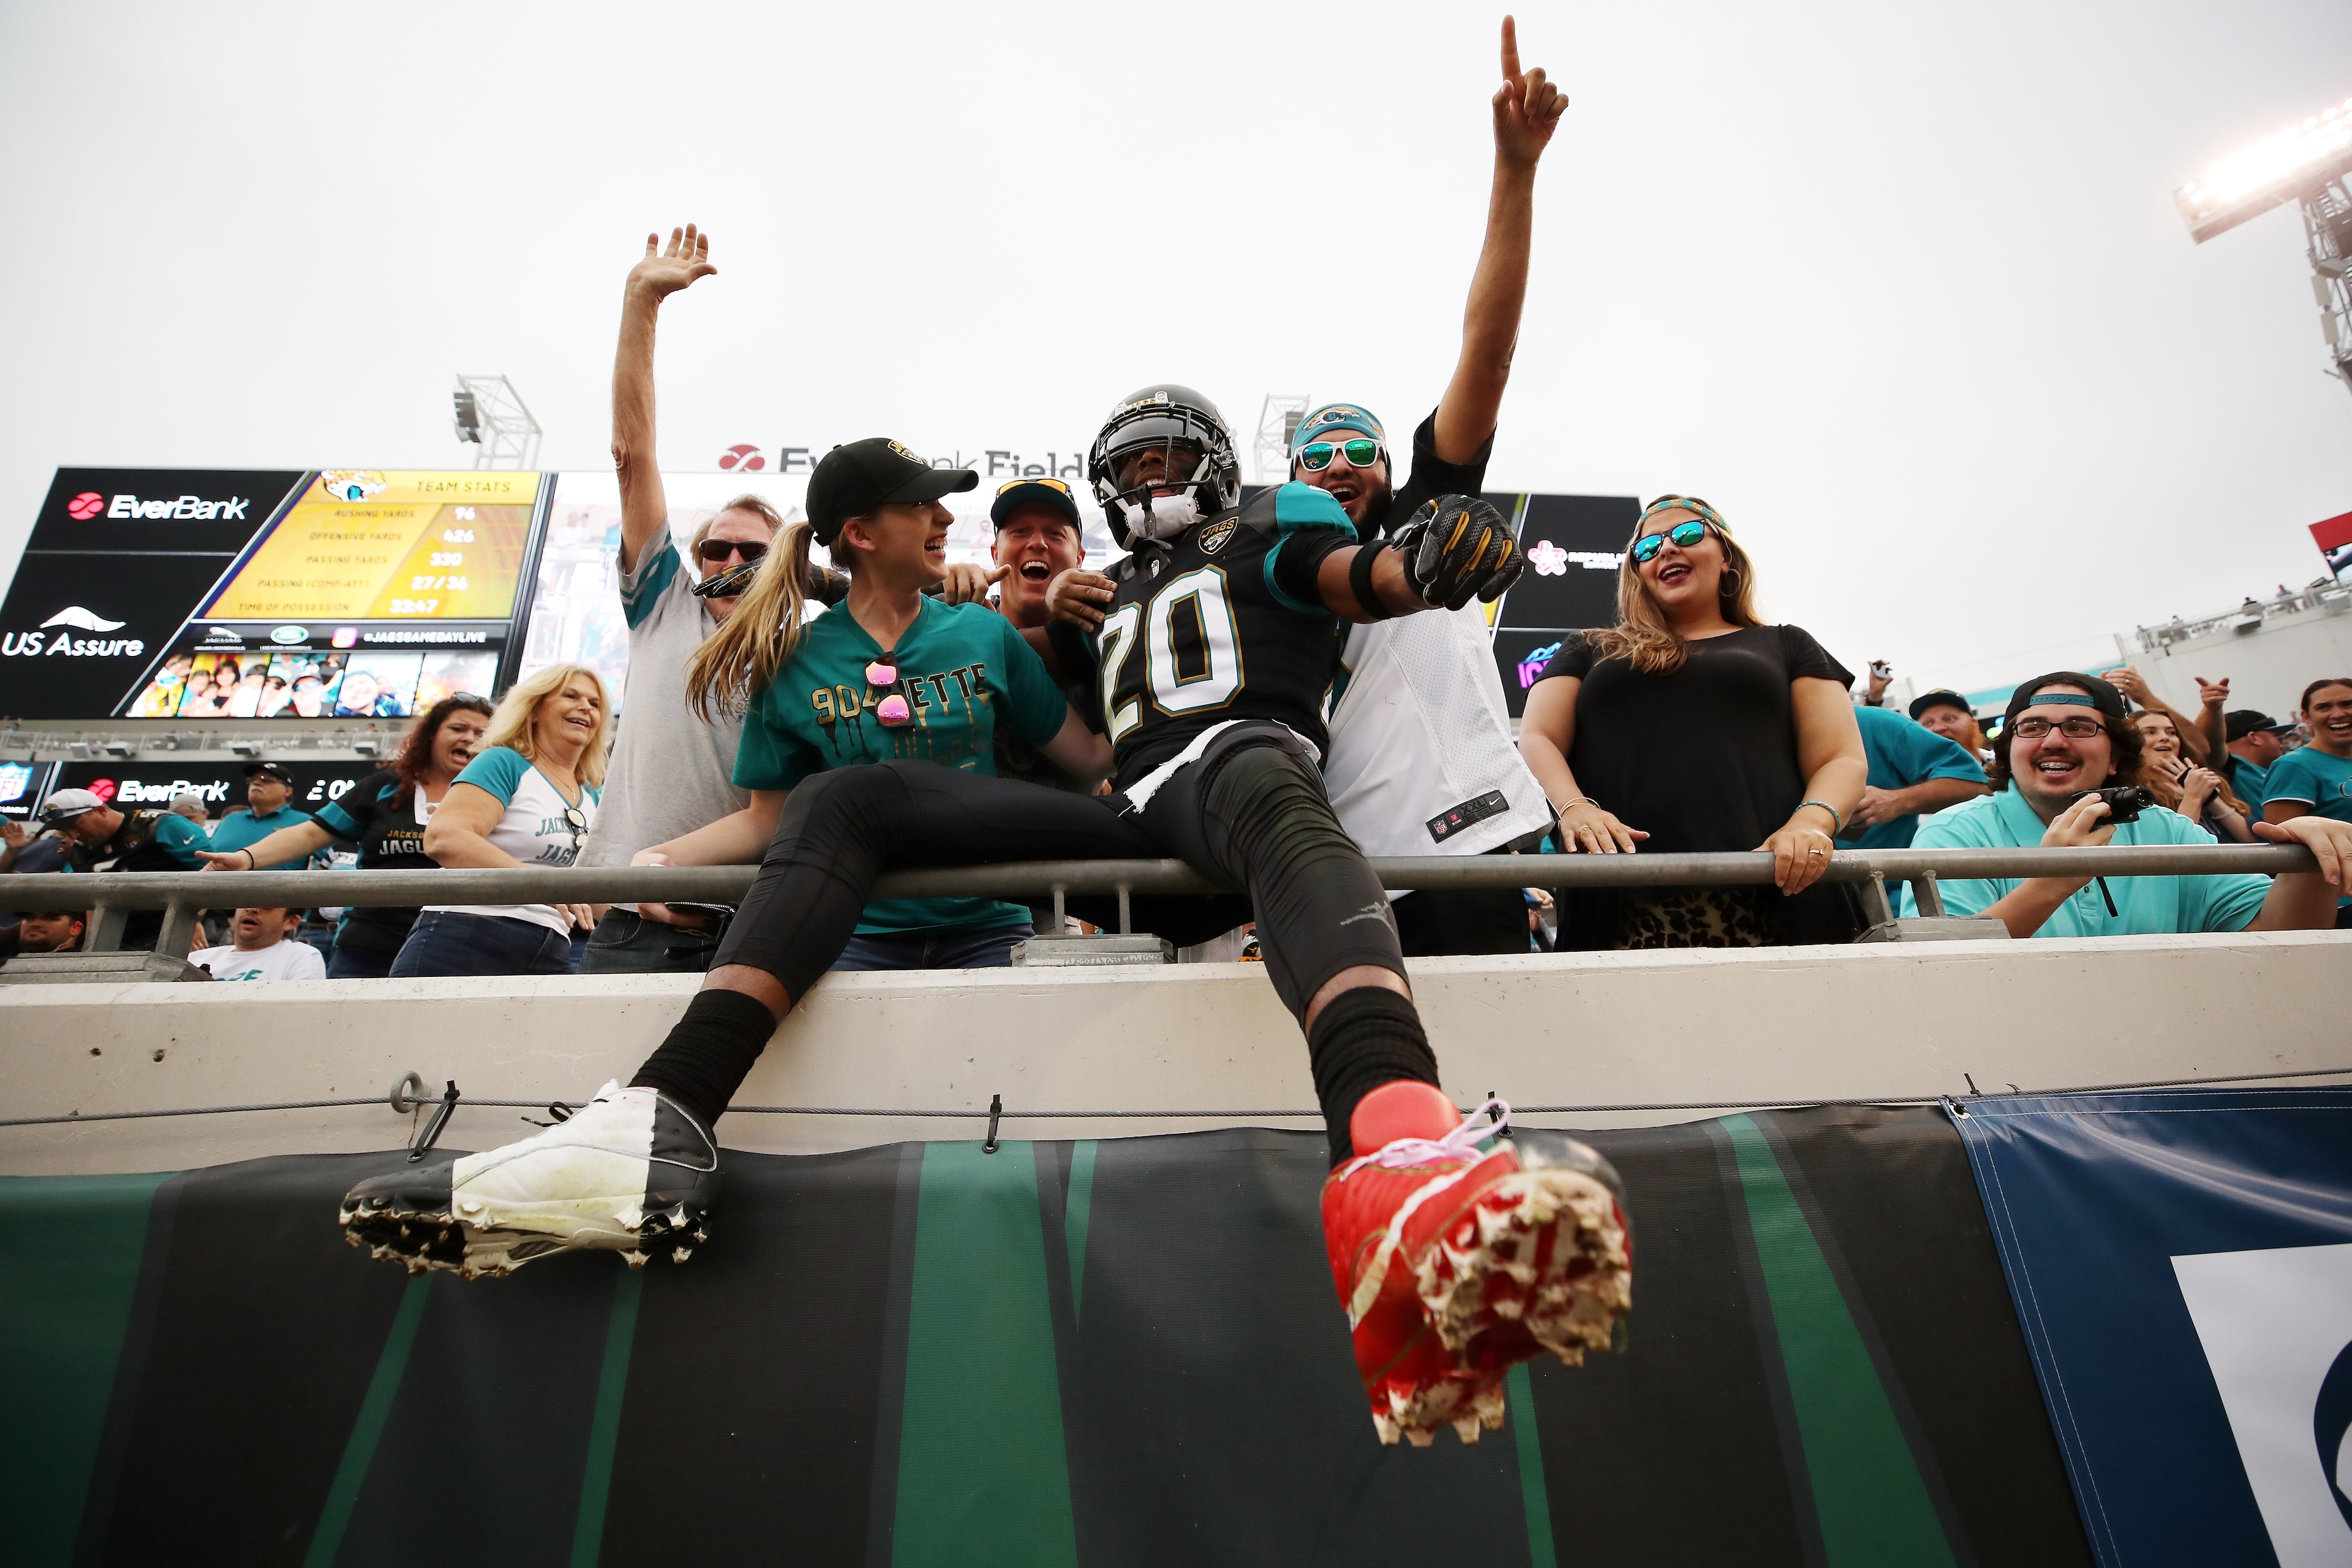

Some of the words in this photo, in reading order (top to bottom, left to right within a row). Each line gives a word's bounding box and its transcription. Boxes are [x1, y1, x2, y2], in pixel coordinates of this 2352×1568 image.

[986, 451, 1082, 477] Field
[417, 481, 458, 491] TEAM
[463, 481, 511, 492] STATS
[107, 494, 247, 520] EverBank
[455, 506, 476, 520] 96
[443, 529, 475, 543] 426
[1202, 519, 1235, 538] JAGS
[429, 552, 463, 566] 330
[257, 579, 303, 588] PASSING
[411, 576, 469, 590] 27/36
[239, 603, 262, 611] TIME
[266, 603, 279, 611] OF
[282, 603, 349, 611] POSSESSION
[390, 599, 439, 613] 33:47
[1, 632, 45, 657] US
[46, 632, 145, 657] Assure
[1096, 564, 1243, 747] 20
[0, 780, 18, 797] FL
[117, 780, 228, 802] EverBank
[1459, 800, 1487, 815] XXL
